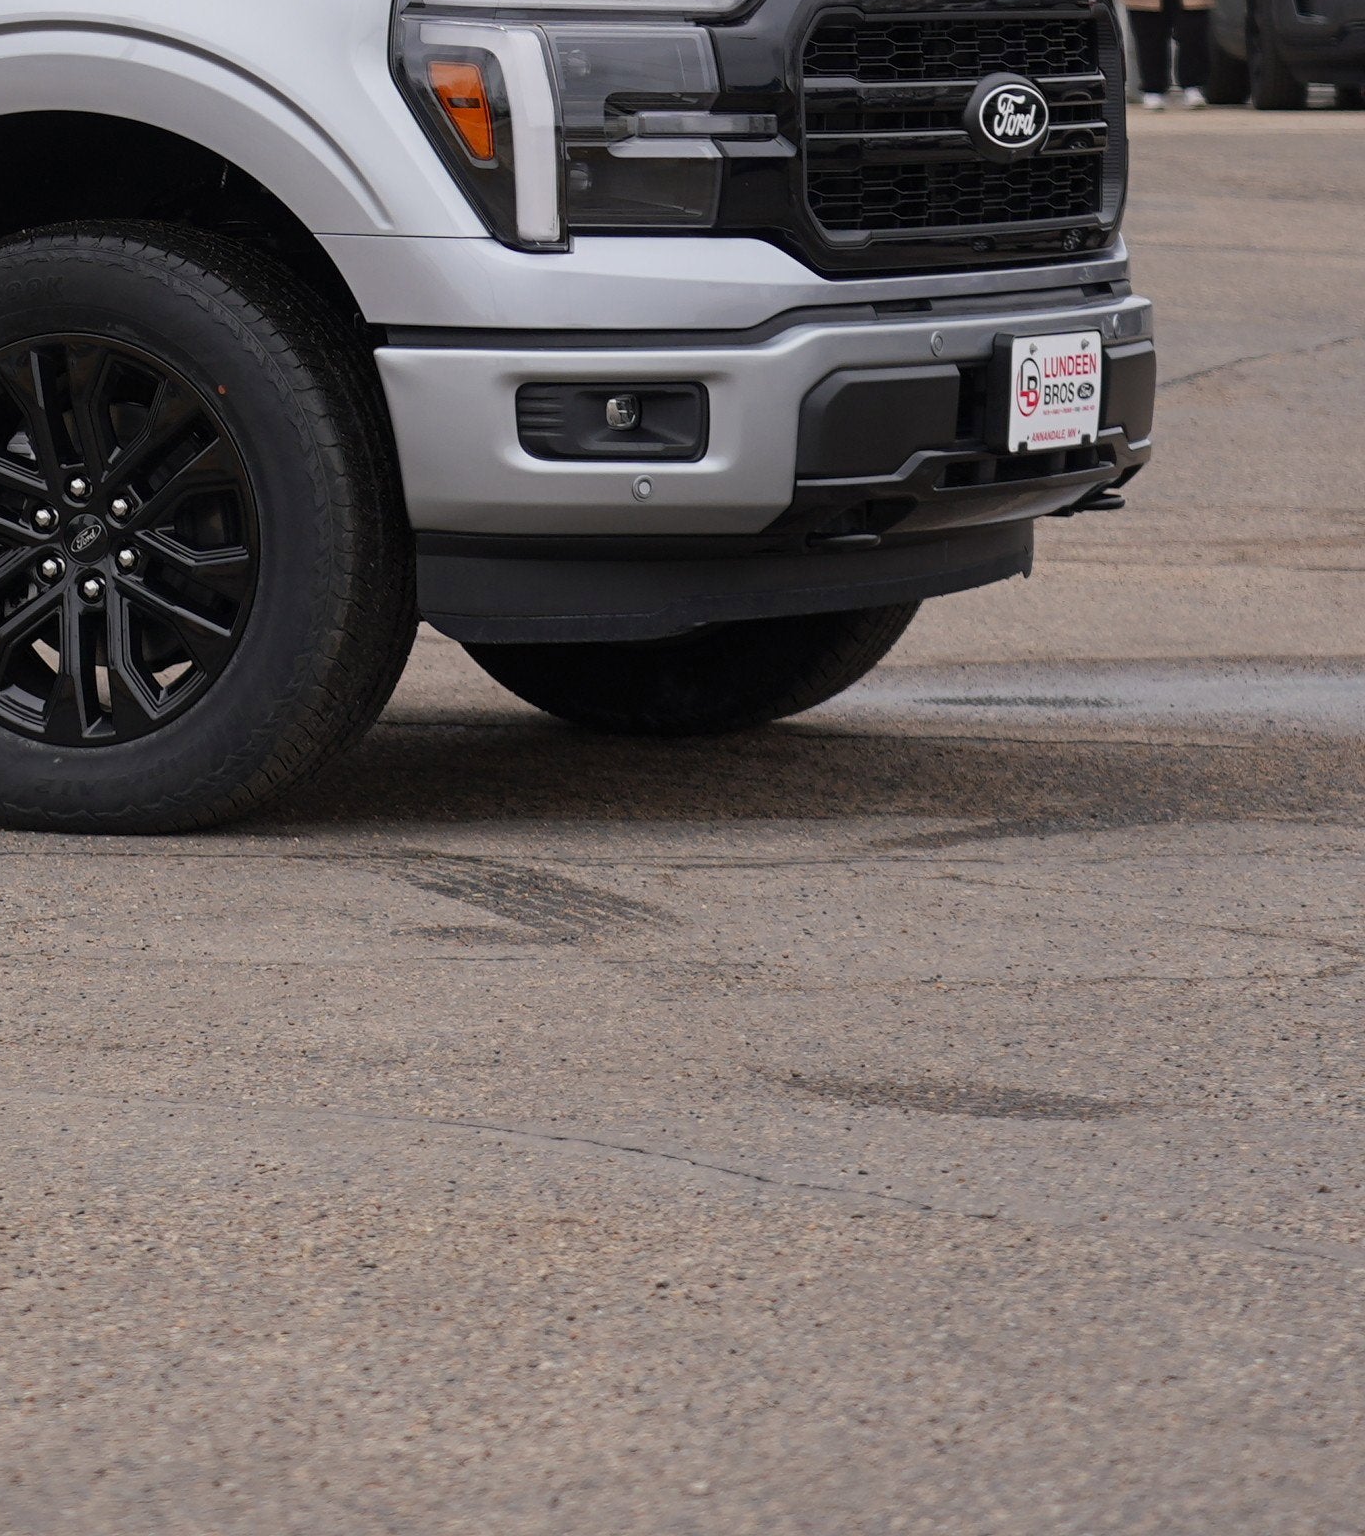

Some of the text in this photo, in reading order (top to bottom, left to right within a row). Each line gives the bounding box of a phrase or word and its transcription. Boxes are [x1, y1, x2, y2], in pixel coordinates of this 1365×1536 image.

[993, 93, 1036, 136] Ford
[1043, 353, 1096, 378] LUNDEEN
[1043, 382, 1075, 405] BROS
[75, 528, 96, 550] Ford
